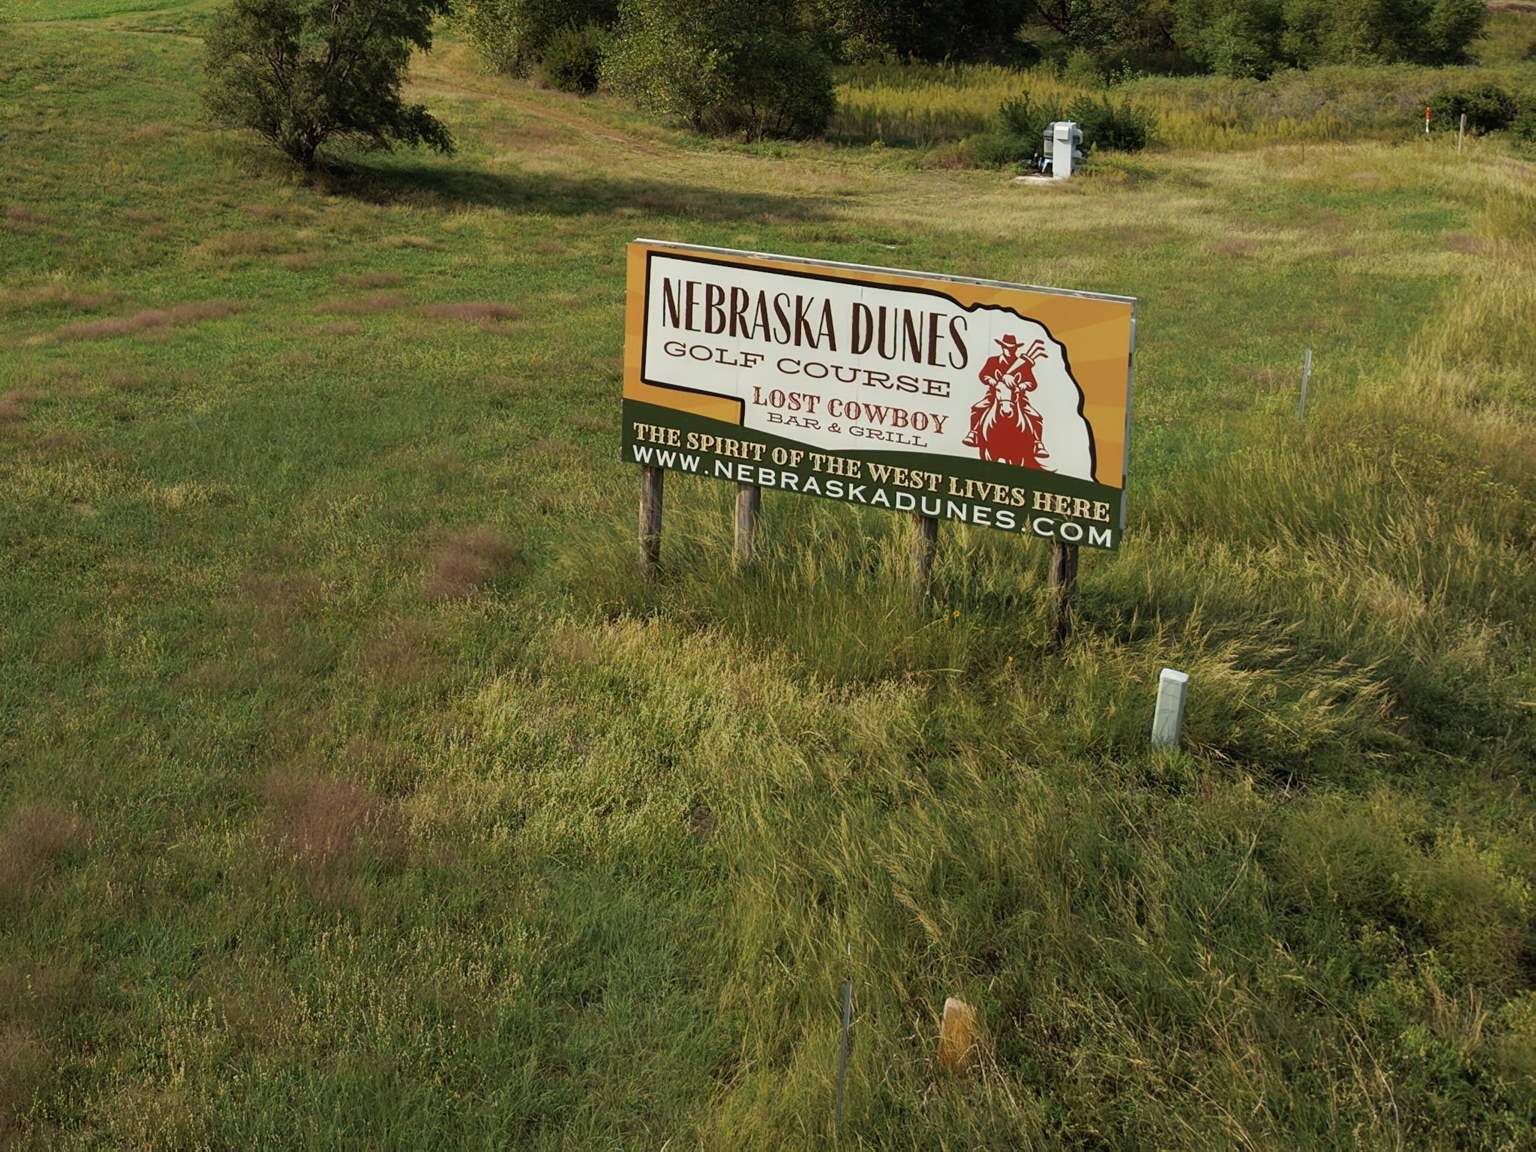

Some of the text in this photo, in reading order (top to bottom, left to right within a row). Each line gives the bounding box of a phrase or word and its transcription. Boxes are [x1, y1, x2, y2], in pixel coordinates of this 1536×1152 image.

[662, 277, 969, 370] NEBRASKA DUNES
[663, 341, 951, 398] GOLF COURSE
[752, 385, 950, 434] LOST COWBOY
[767, 412, 928, 448] BAR & GRILL
[632, 444, 1113, 548] WWW.NEBRASKADUNES.COM
[633, 422, 1111, 523] THE SPIRIT OF THE WEST LIVES HERE
